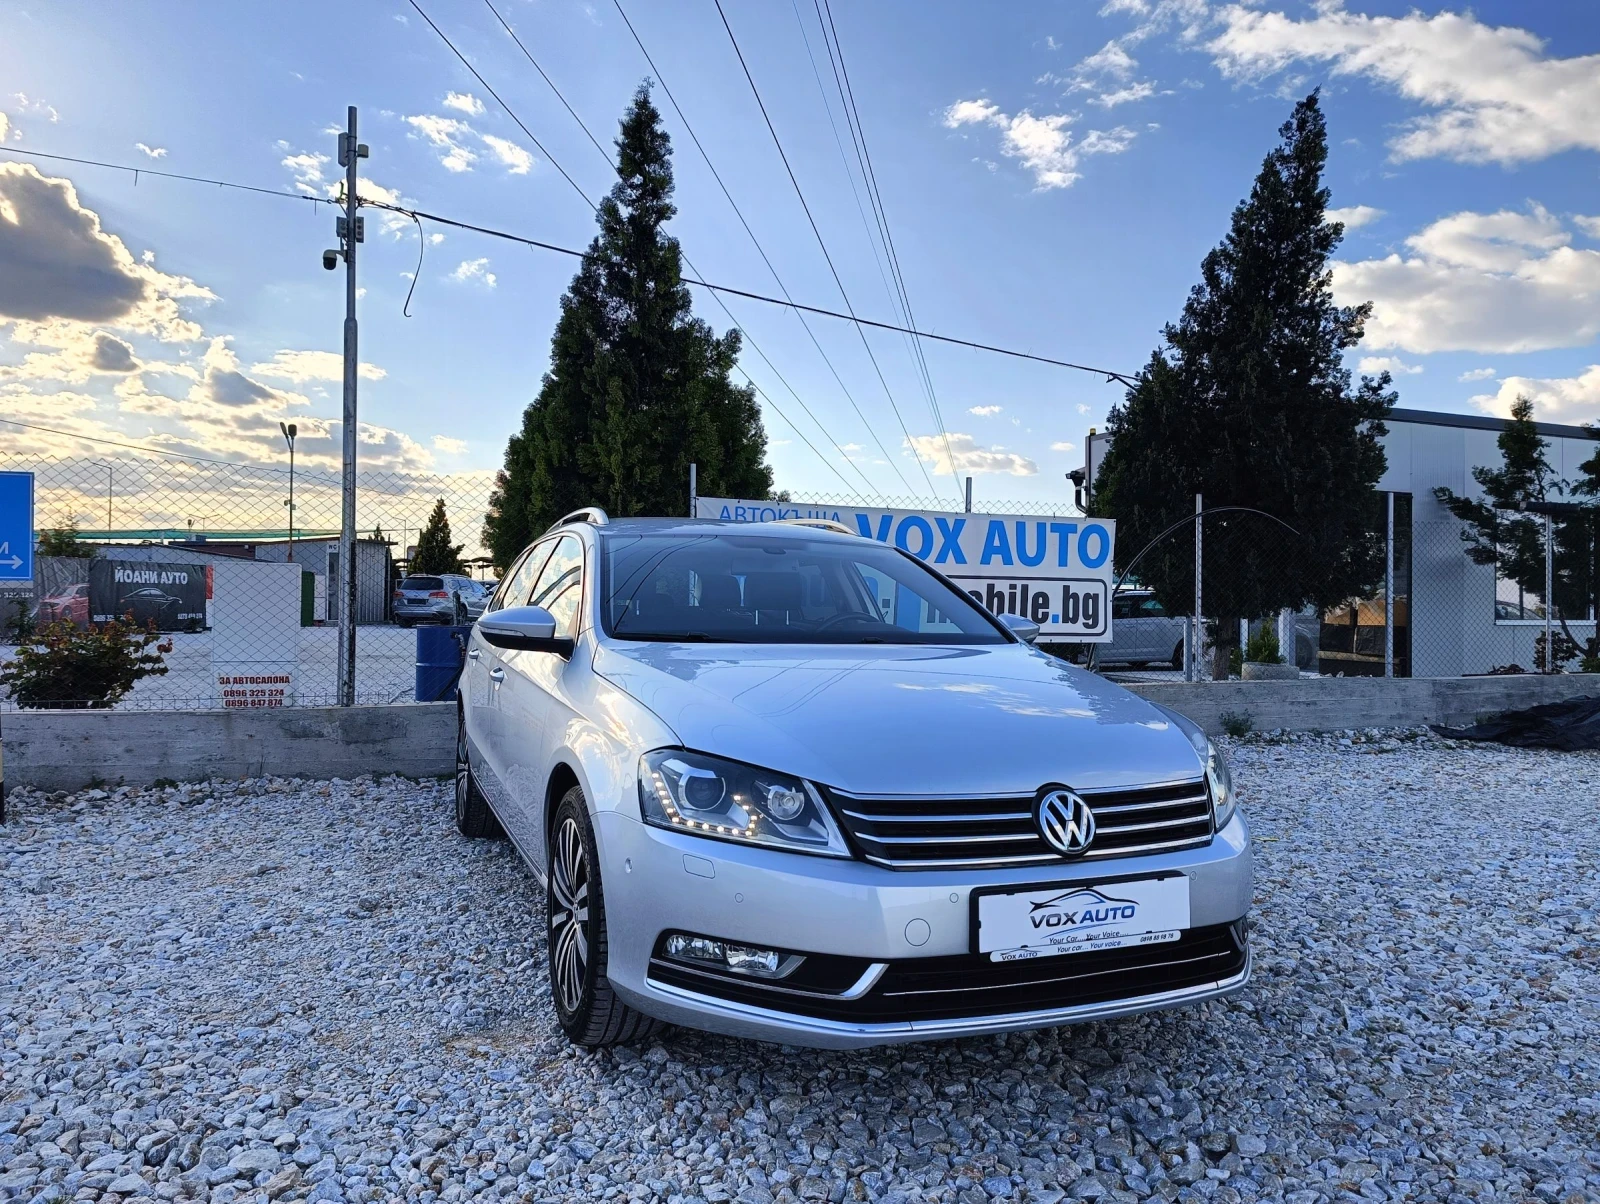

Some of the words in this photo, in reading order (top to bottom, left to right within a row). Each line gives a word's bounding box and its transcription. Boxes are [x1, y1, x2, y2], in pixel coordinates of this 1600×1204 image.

[855, 513, 968, 564] VOX
[980, 520, 1110, 569] AUTO
[114, 567, 158, 584] ЙОАНИ
[161, 571, 188, 585] АУТО
[219, 677, 231, 685] ЗА
[233, 676, 290, 685] АВТОСАЛОНА
[223, 690, 247, 698] 0896
[268, 689, 284, 697] 324
[225, 700, 249, 708] 0896
[250, 699, 266, 707] 847
[267, 699, 283, 707] 874
[1049, 937, 1064, 945] Your
